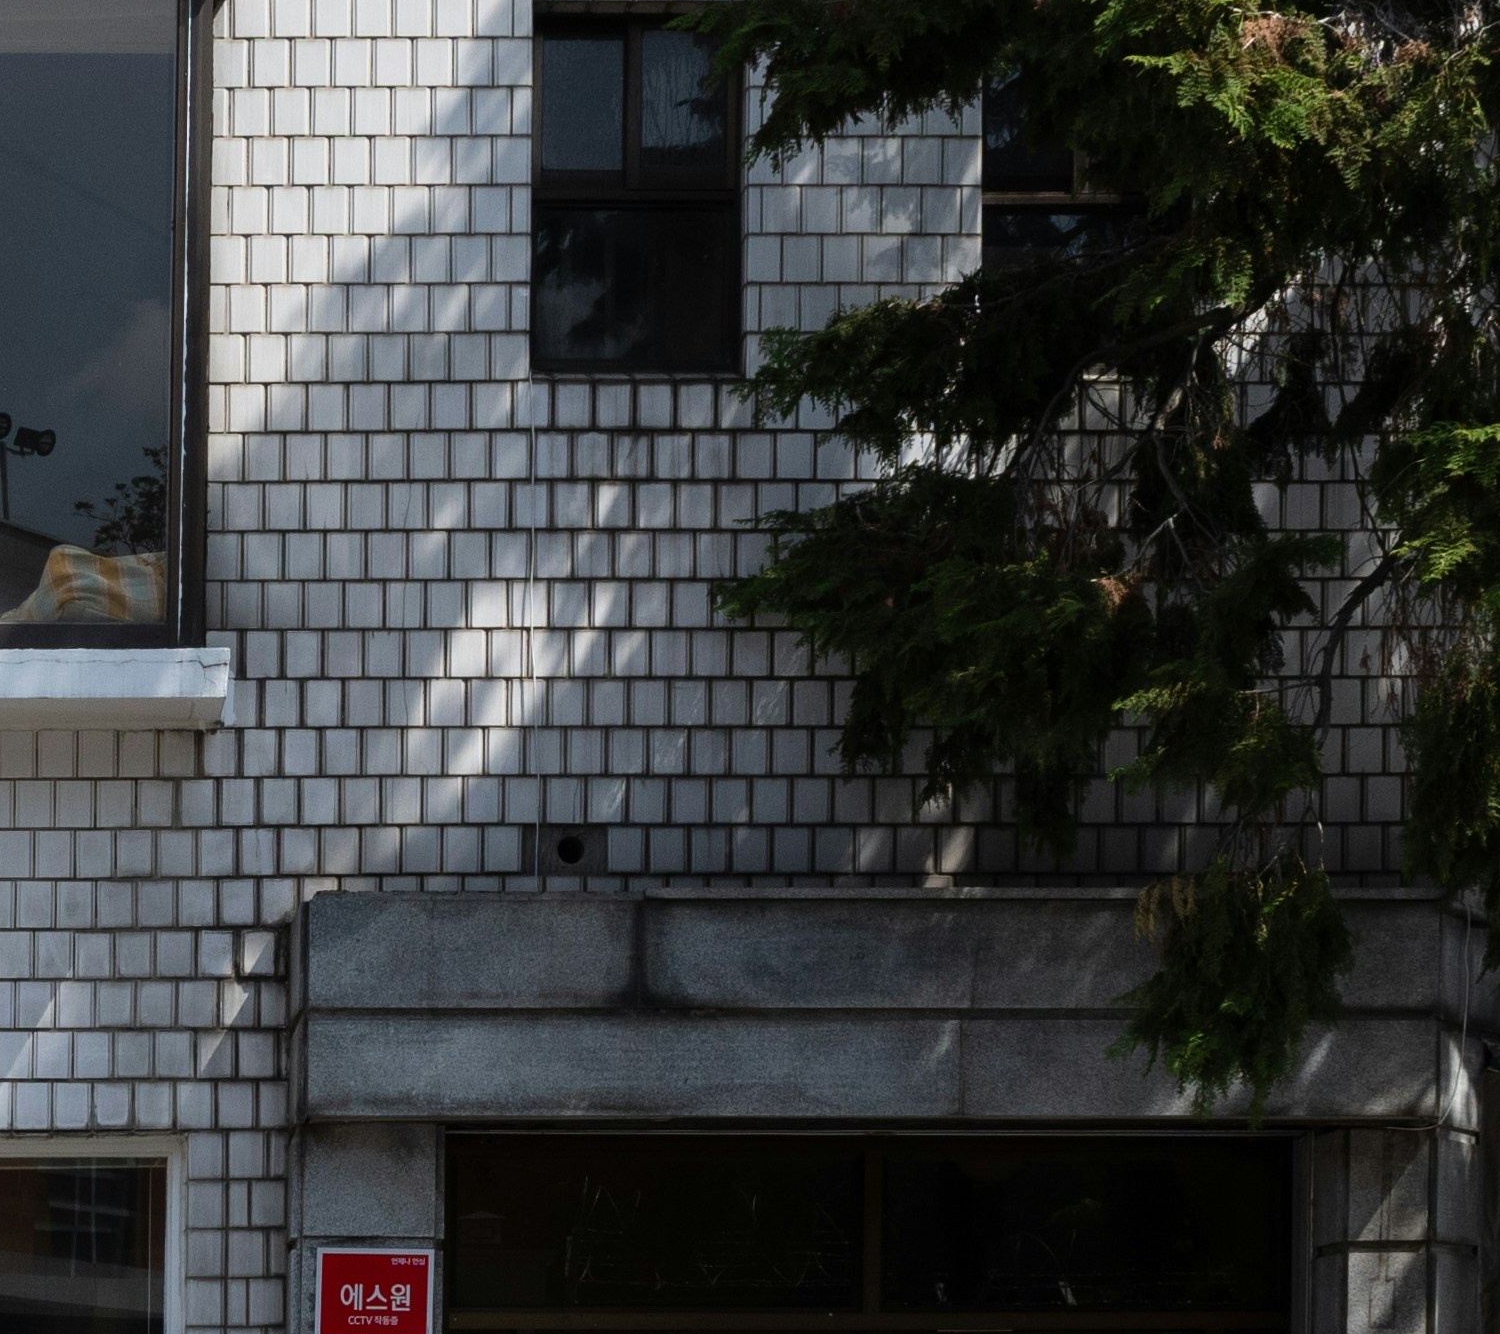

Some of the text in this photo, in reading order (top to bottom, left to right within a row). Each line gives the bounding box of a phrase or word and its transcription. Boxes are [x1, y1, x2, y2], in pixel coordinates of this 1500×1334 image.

[340, 1283, 411, 1312] 에스원
[348, 1316, 398, 1326] CCTV 작동중
